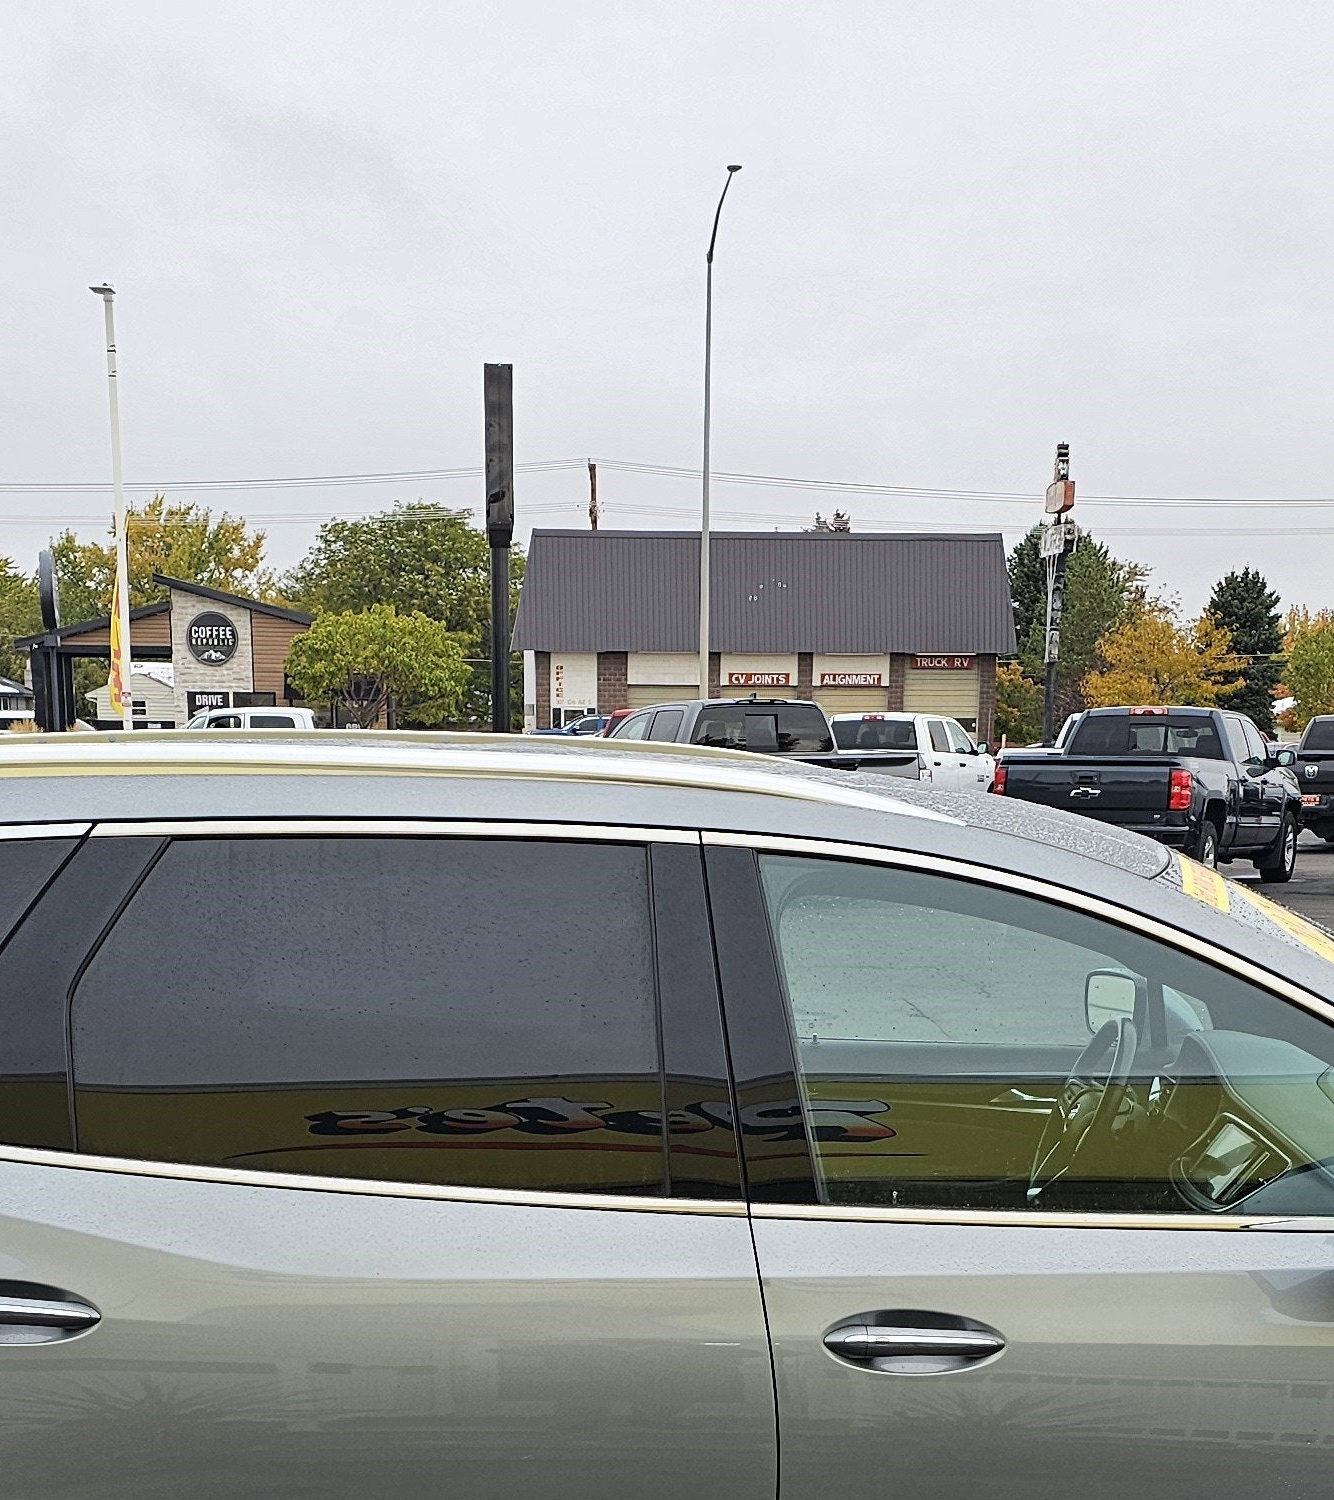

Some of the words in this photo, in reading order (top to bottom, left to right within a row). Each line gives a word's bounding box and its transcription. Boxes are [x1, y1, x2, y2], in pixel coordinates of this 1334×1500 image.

[191, 626, 233, 639] COFFEE
[192, 638, 234, 646] REPUBLIC
[916, 657, 948, 667] TRUCK
[954, 657, 970, 667] RV
[731, 674, 746, 684] CV
[747, 674, 786, 685] JOINTS
[823, 674, 880, 685] ALIGNMENT
[195, 694, 224, 706] DRIVE
